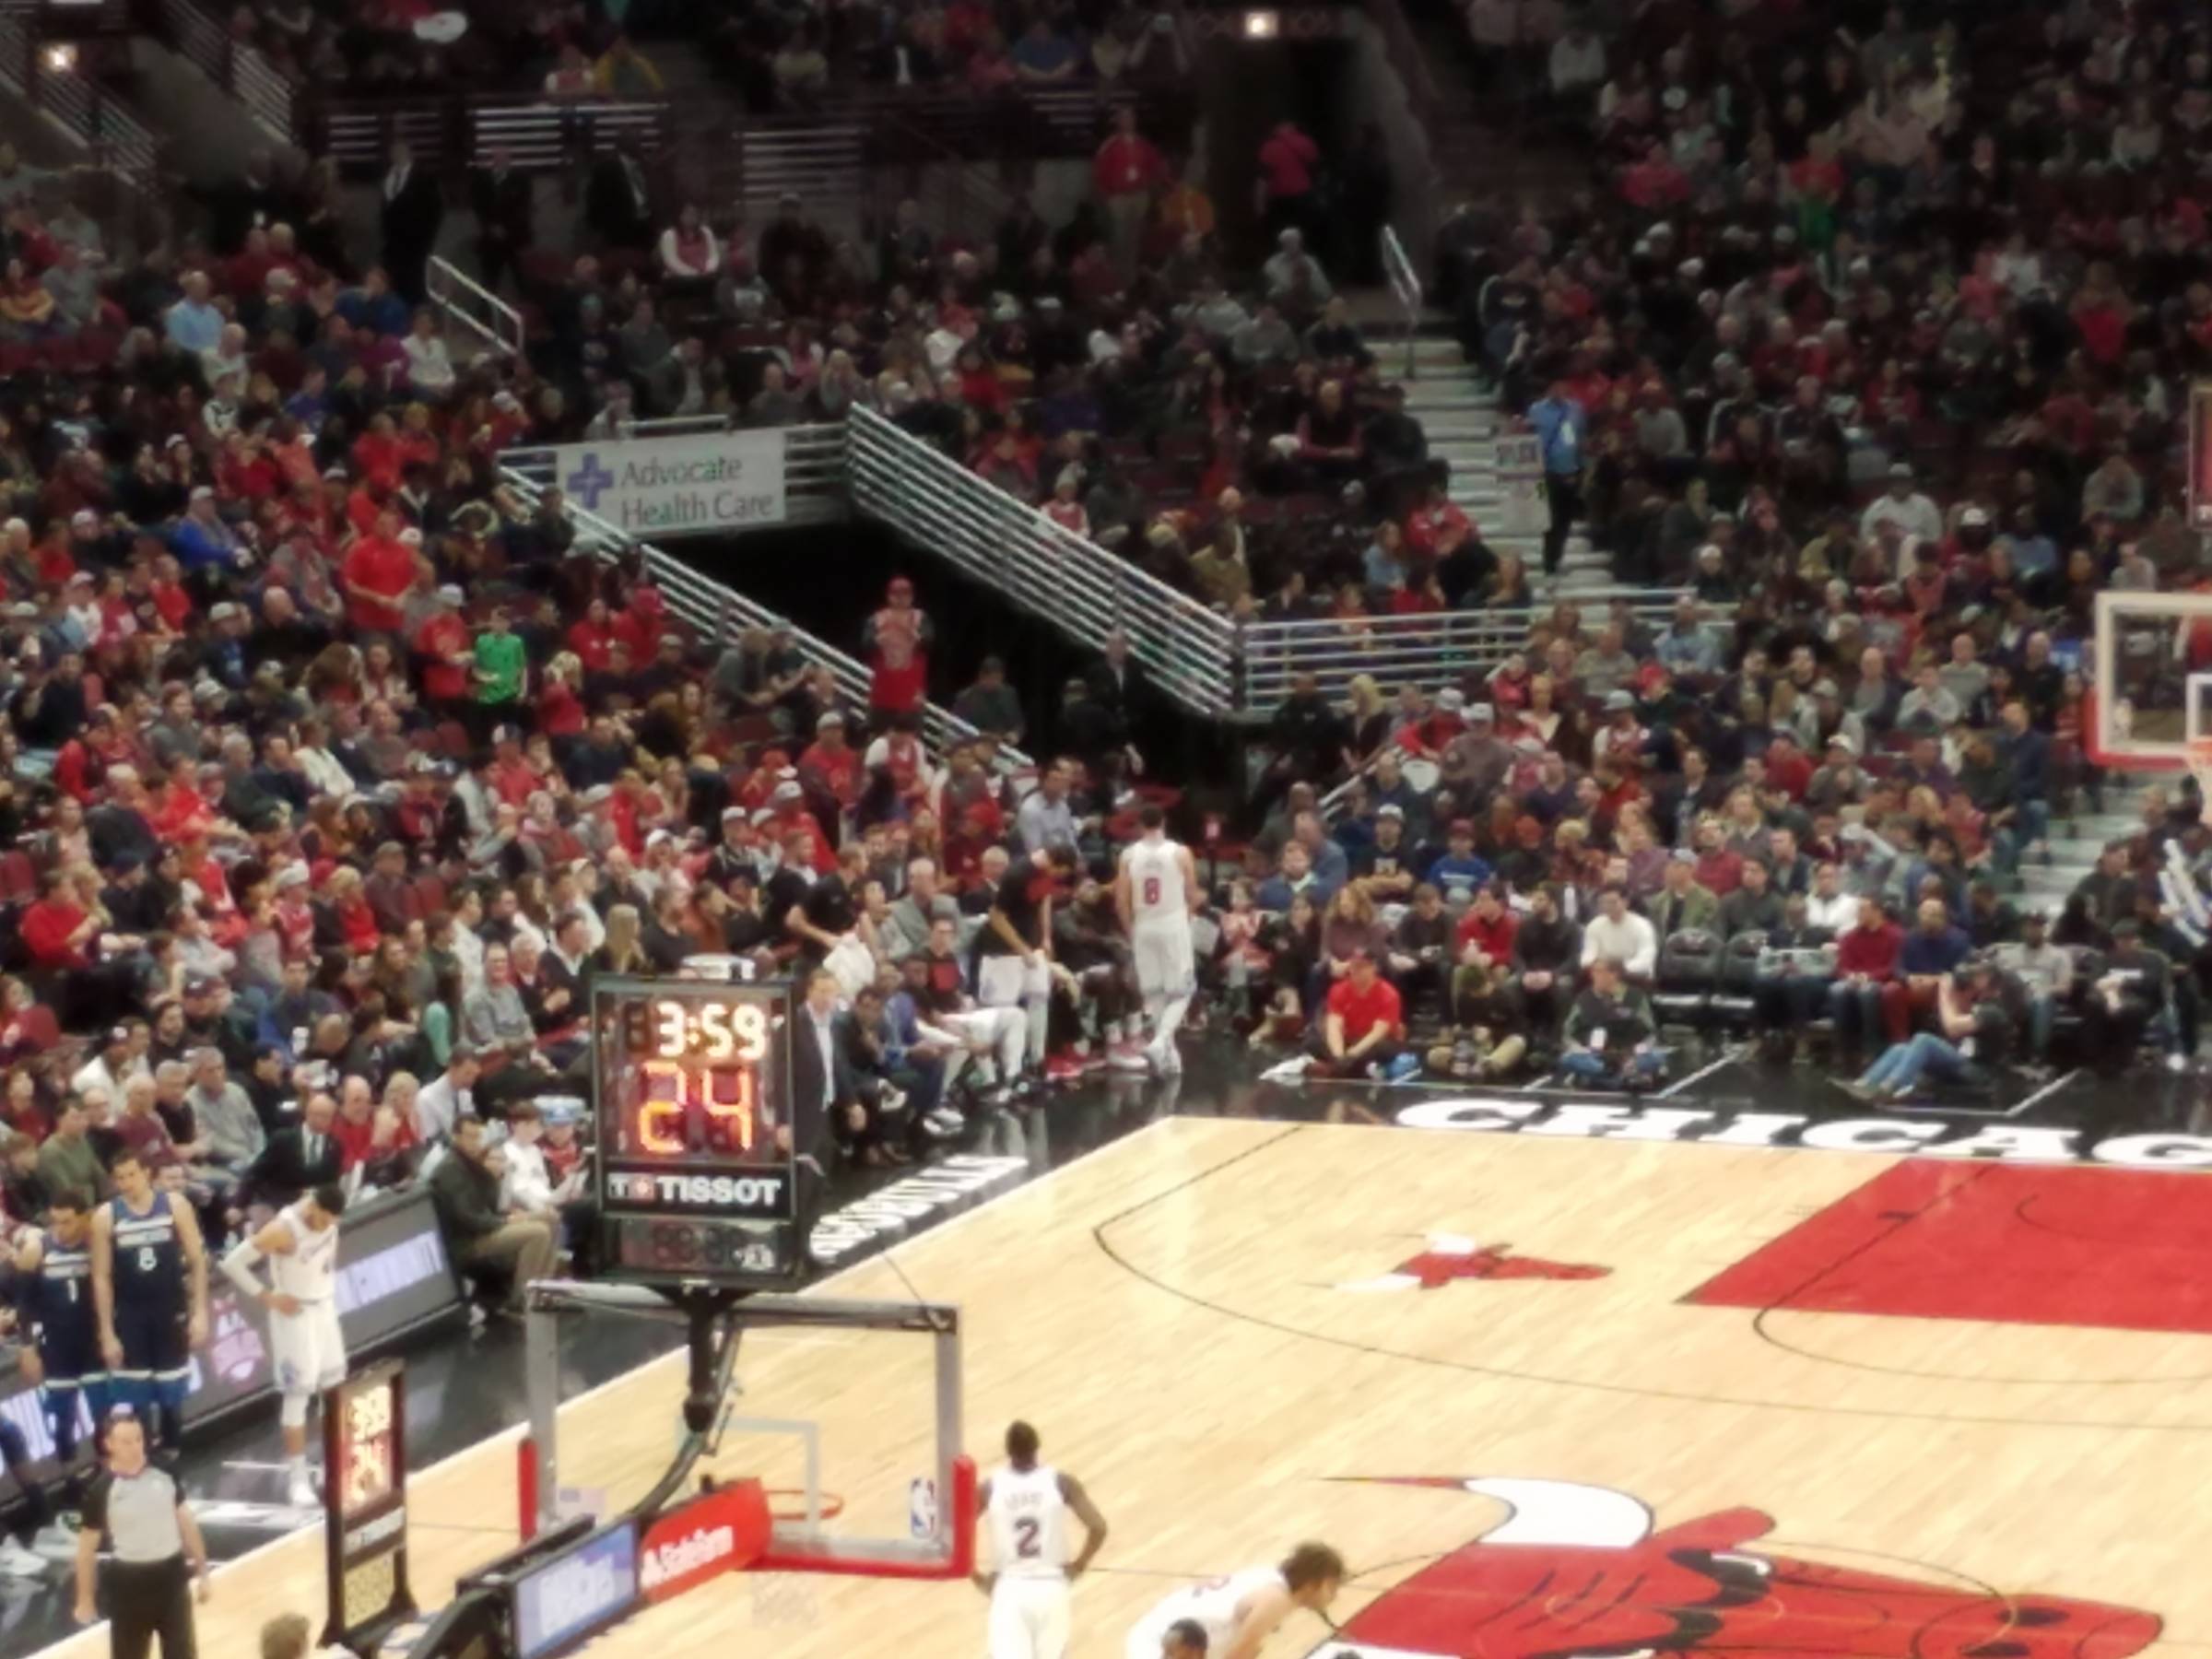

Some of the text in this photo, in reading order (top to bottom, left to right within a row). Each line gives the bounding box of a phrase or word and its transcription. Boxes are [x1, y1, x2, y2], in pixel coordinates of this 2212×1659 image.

[620, 456, 744, 488] Advocate
[620, 490, 774, 527] Health Care
[1144, 877, 1159, 906] 8
[656, 1000, 767, 1060] 3:59
[638, 1061, 754, 1152] 24
[655, 1174, 782, 1206] TISSOT
[1014, 1514, 1041, 1559] 2
